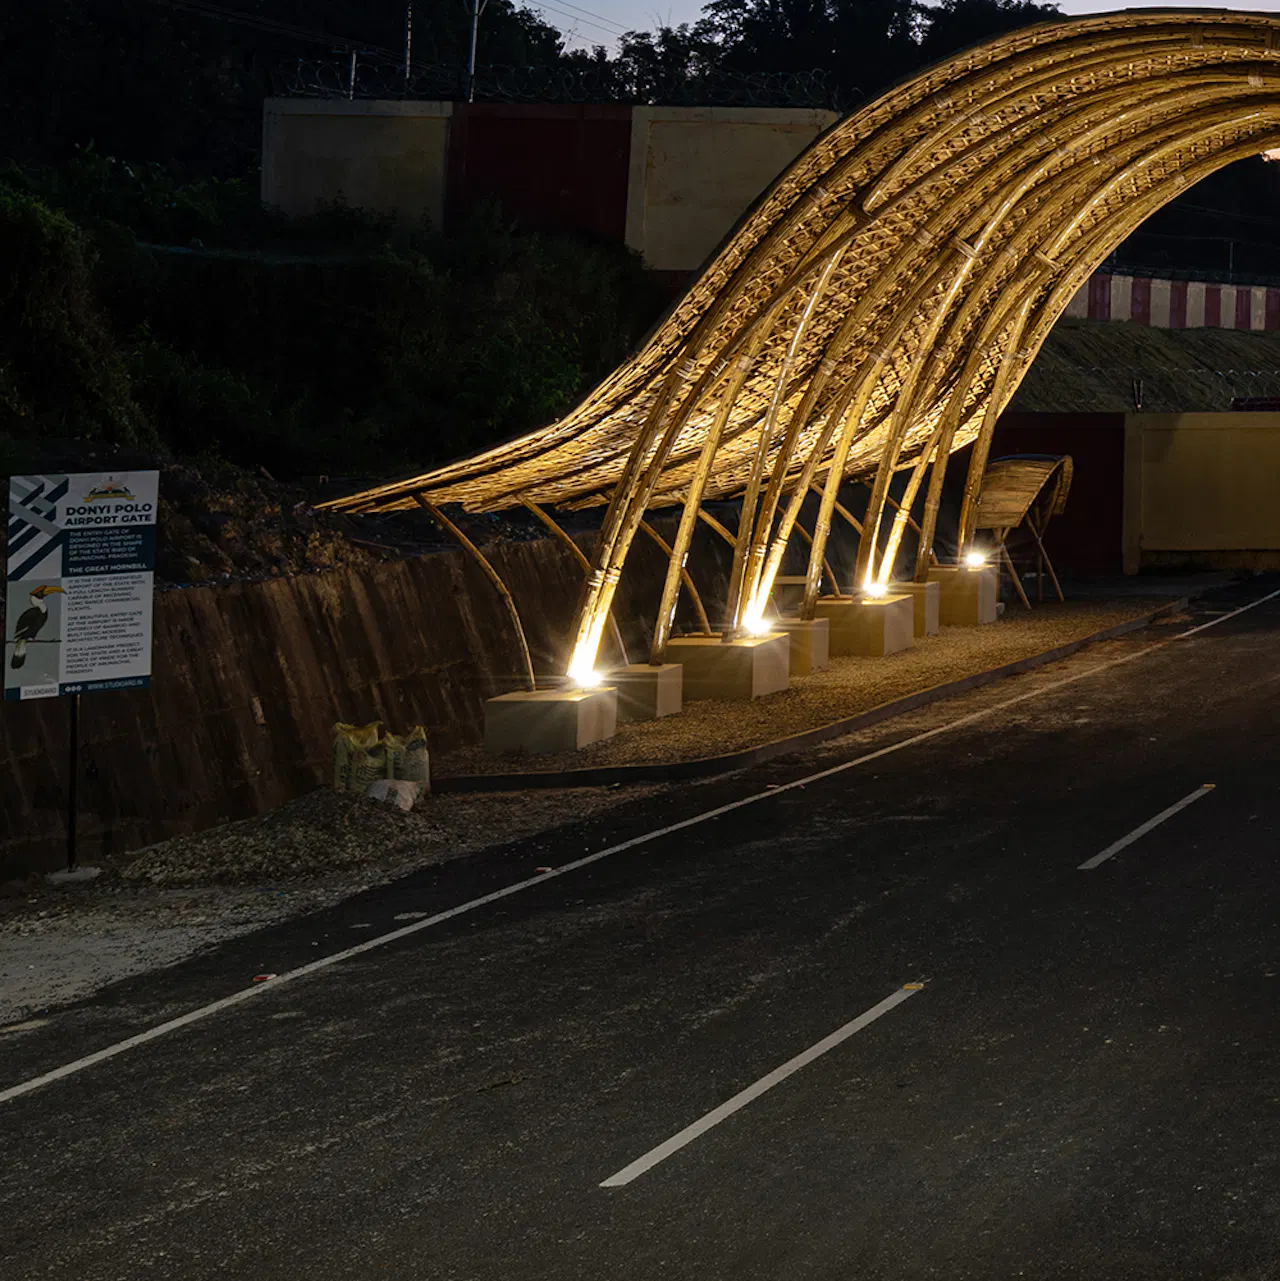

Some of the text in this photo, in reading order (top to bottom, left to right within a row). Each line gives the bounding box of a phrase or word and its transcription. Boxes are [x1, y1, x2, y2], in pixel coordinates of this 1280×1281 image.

[66, 503, 152, 516] DONYI POLO
[65, 514, 152, 525] AIRPORT GATE
